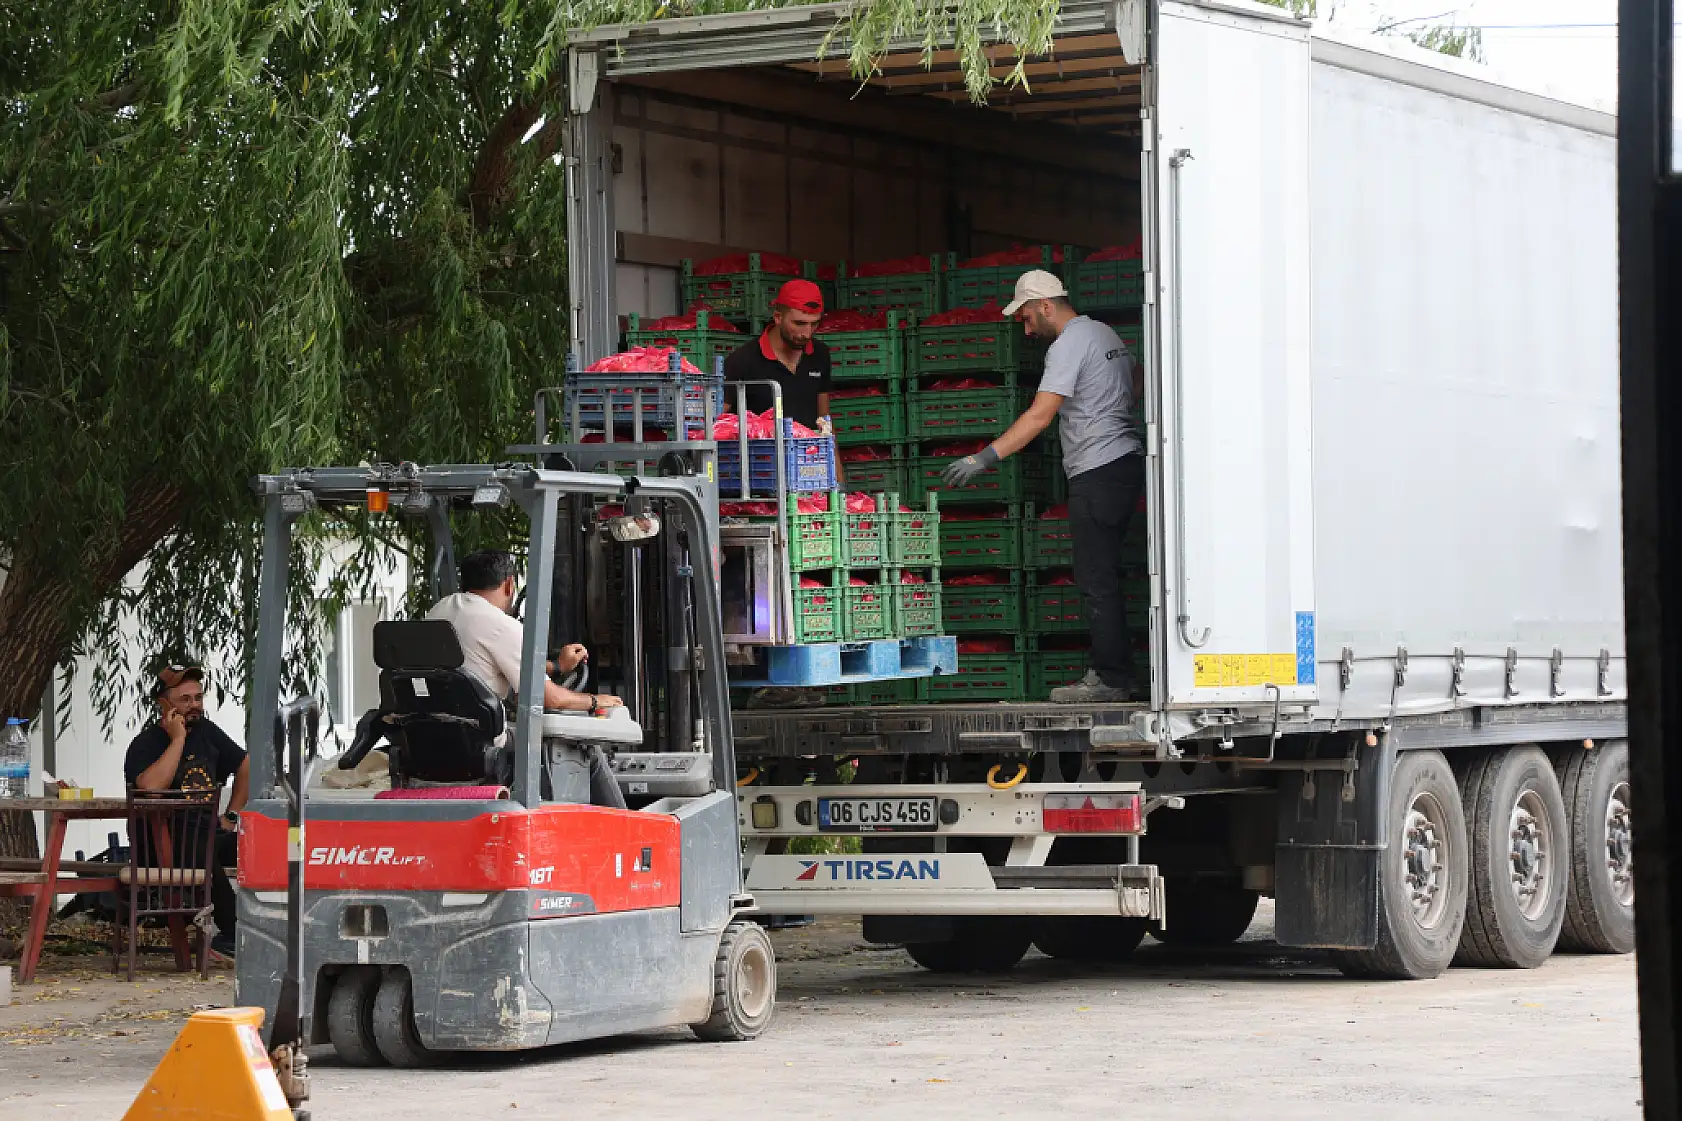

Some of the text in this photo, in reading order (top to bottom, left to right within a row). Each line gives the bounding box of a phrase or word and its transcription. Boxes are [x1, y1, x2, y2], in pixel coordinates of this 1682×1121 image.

[832, 801, 931, 823] 06 CJS 456
[824, 860, 939, 880] TIRSAN
